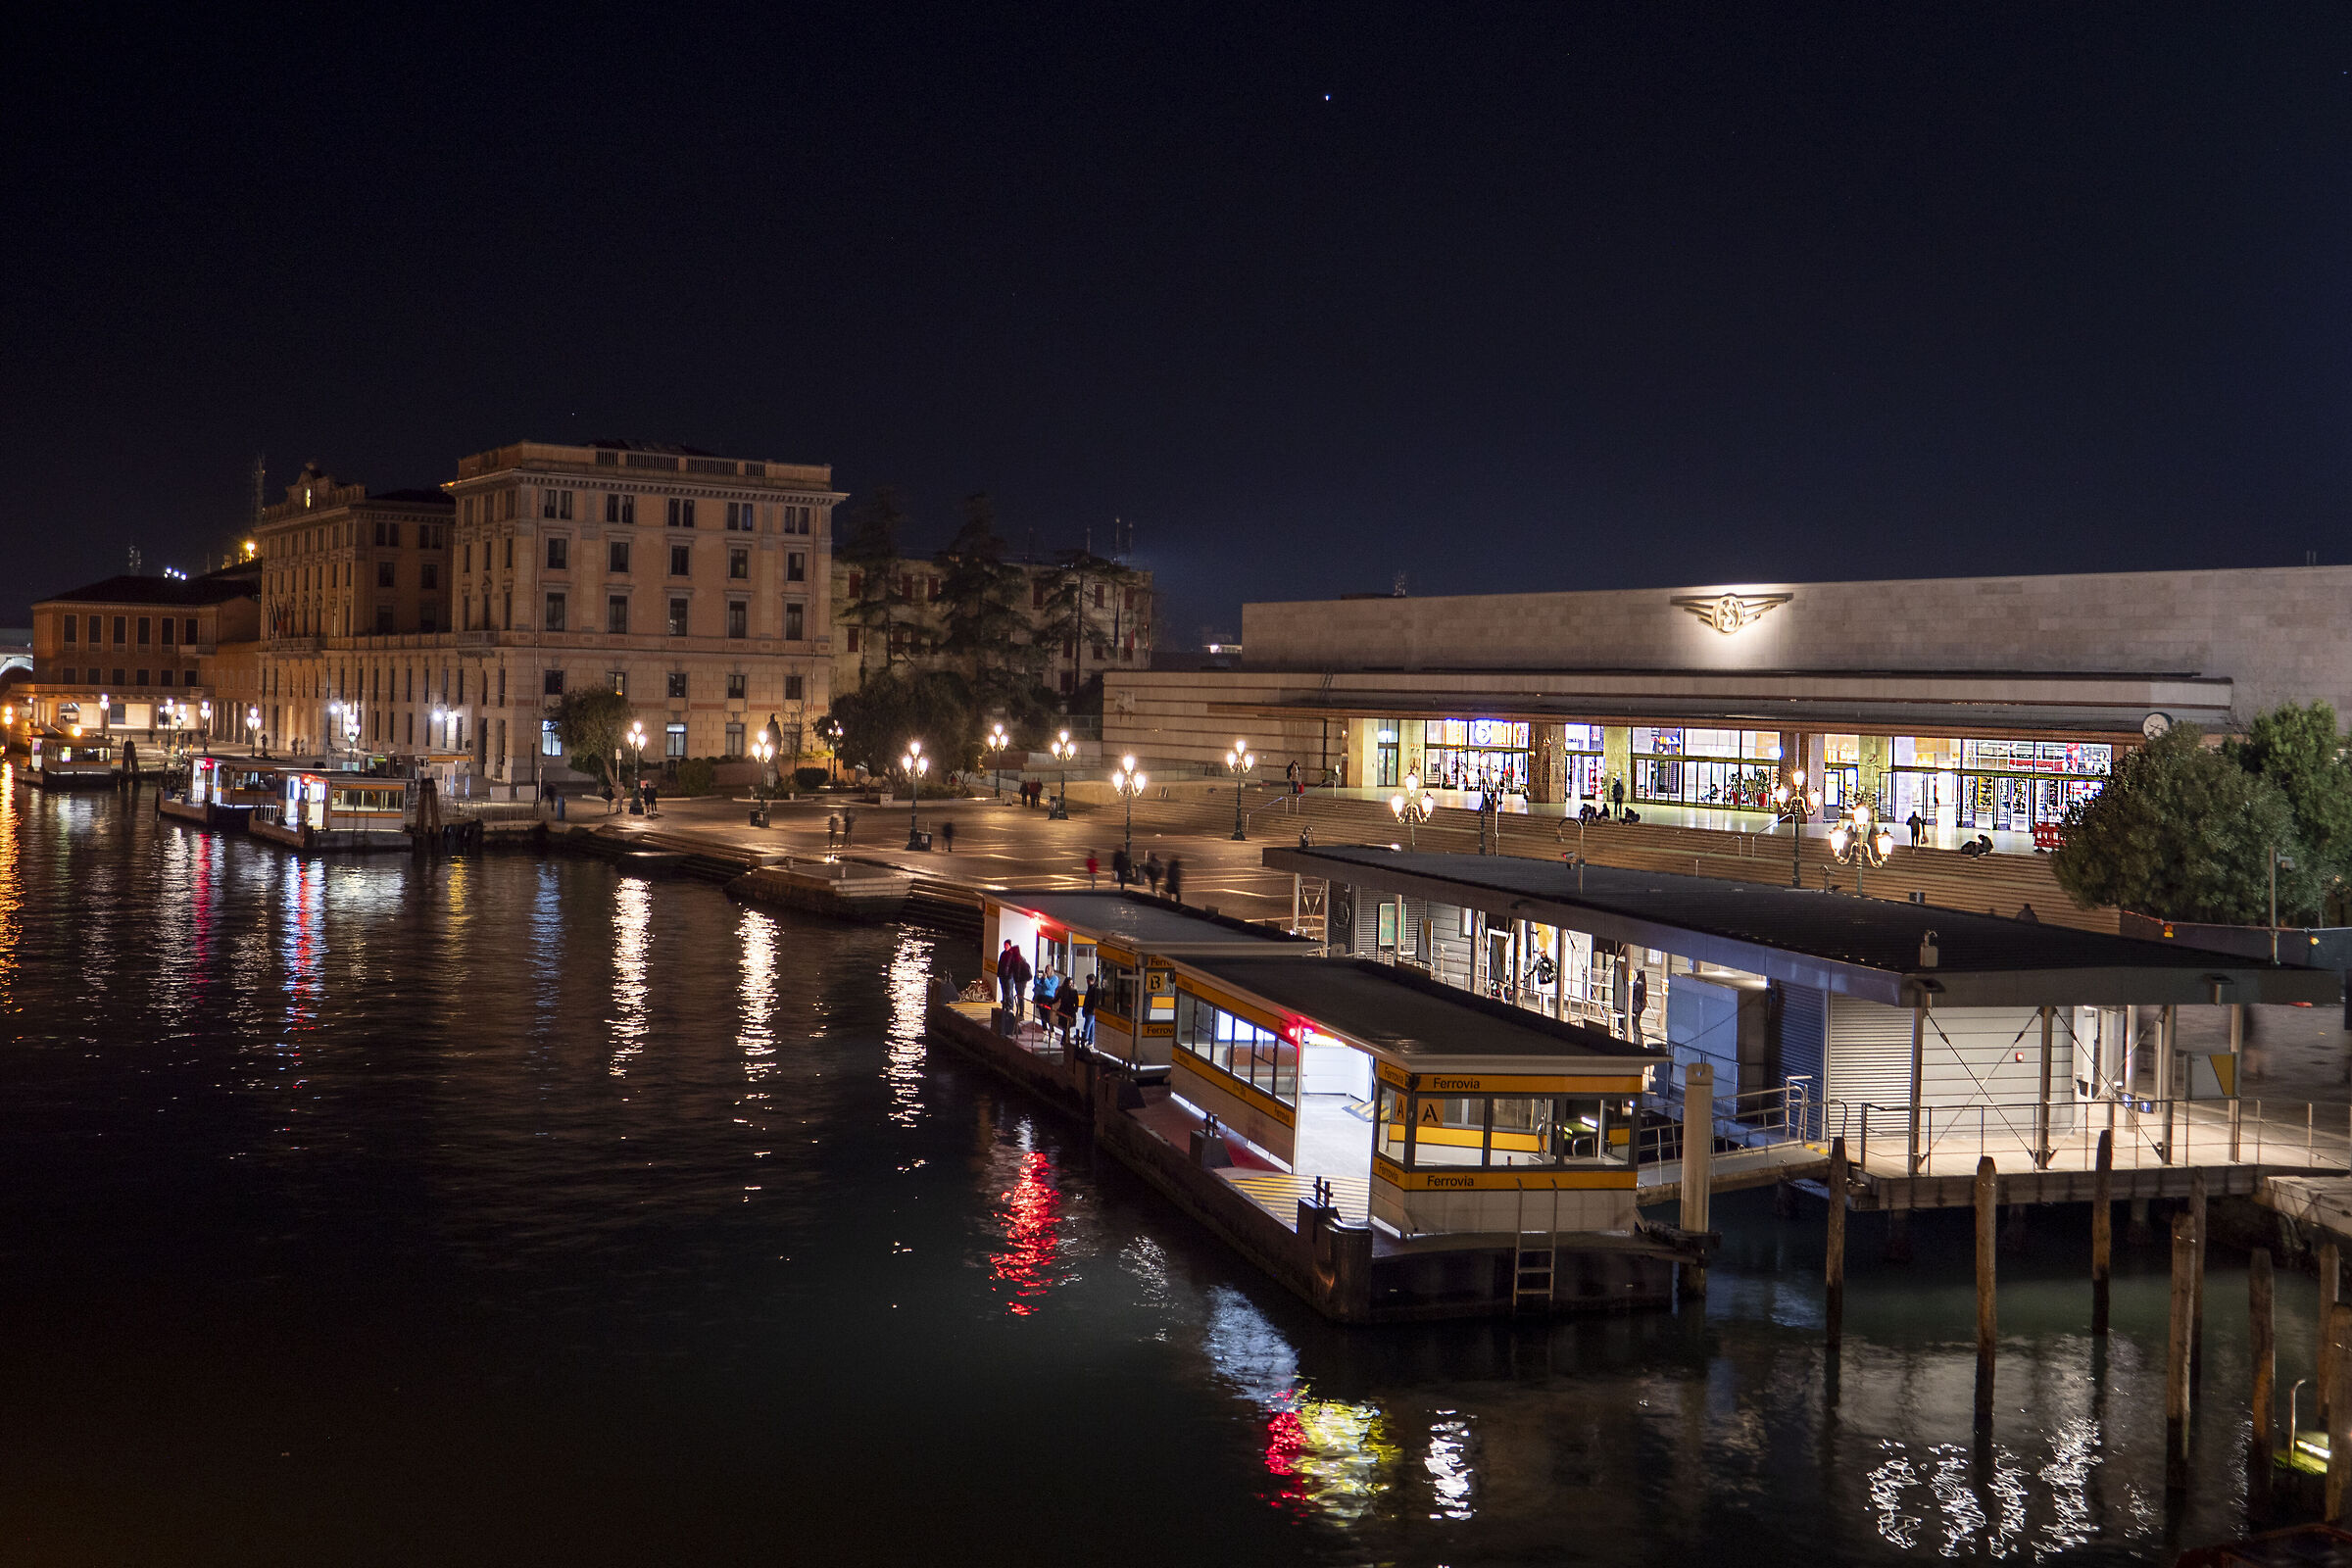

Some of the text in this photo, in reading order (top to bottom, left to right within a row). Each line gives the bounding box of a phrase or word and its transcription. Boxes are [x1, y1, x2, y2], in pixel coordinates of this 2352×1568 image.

[1151, 975, 1161, 990] B
[1384, 1067, 1404, 1084] Ferrovia
[1433, 1077, 1481, 1090] Ferrovia
[1422, 1103, 1438, 1122] A
[1379, 1162, 1398, 1182] Ferrovia
[1427, 1174, 1475, 1188] Ferrovia
